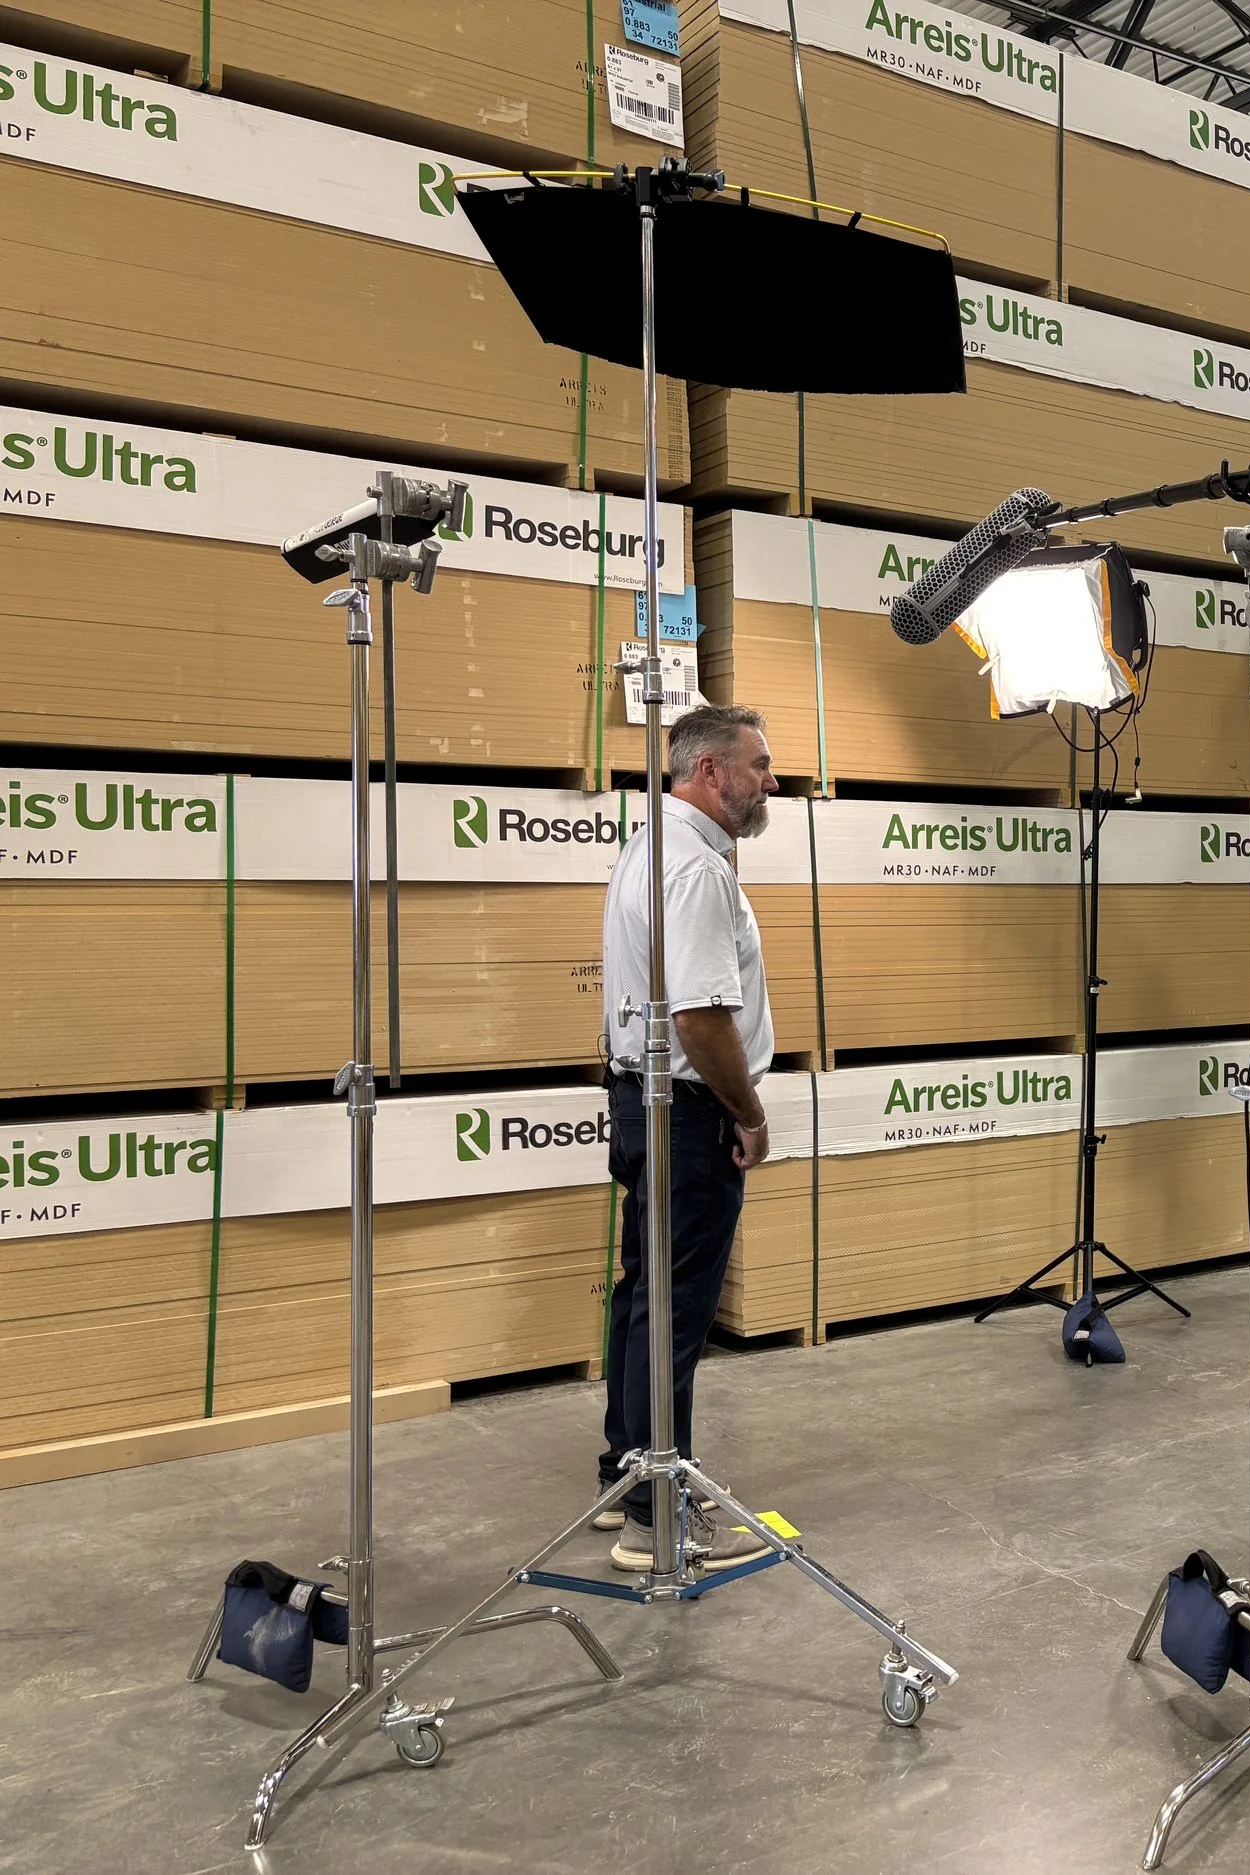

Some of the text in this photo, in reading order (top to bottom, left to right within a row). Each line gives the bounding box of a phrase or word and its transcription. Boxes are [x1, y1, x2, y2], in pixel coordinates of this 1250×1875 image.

[623, 7, 635, 17] 97
[625, 17, 679, 41] 0.883 50
[616, 48, 649, 65] Roseburg
[632, 29, 678, 51] 34 72131
[981, 32, 1057, 93] Ultra
[34, 61, 178, 142] Ultra
[0, 122, 37, 142] DF
[986, 294, 1063, 346] Ultra
[54, 427, 197, 493] Ultra
[3, 487, 56, 507] MDF
[664, 625, 691, 636] 72131
[681, 616, 693, 626] 50
[75, 782, 218, 833] Ultra
[995, 816, 1072, 853] Ultra
[996, 1069, 1072, 1106] Ultra
[502, 1111, 612, 1151] Roseb
[78, 1132, 218, 1182] Ultra
